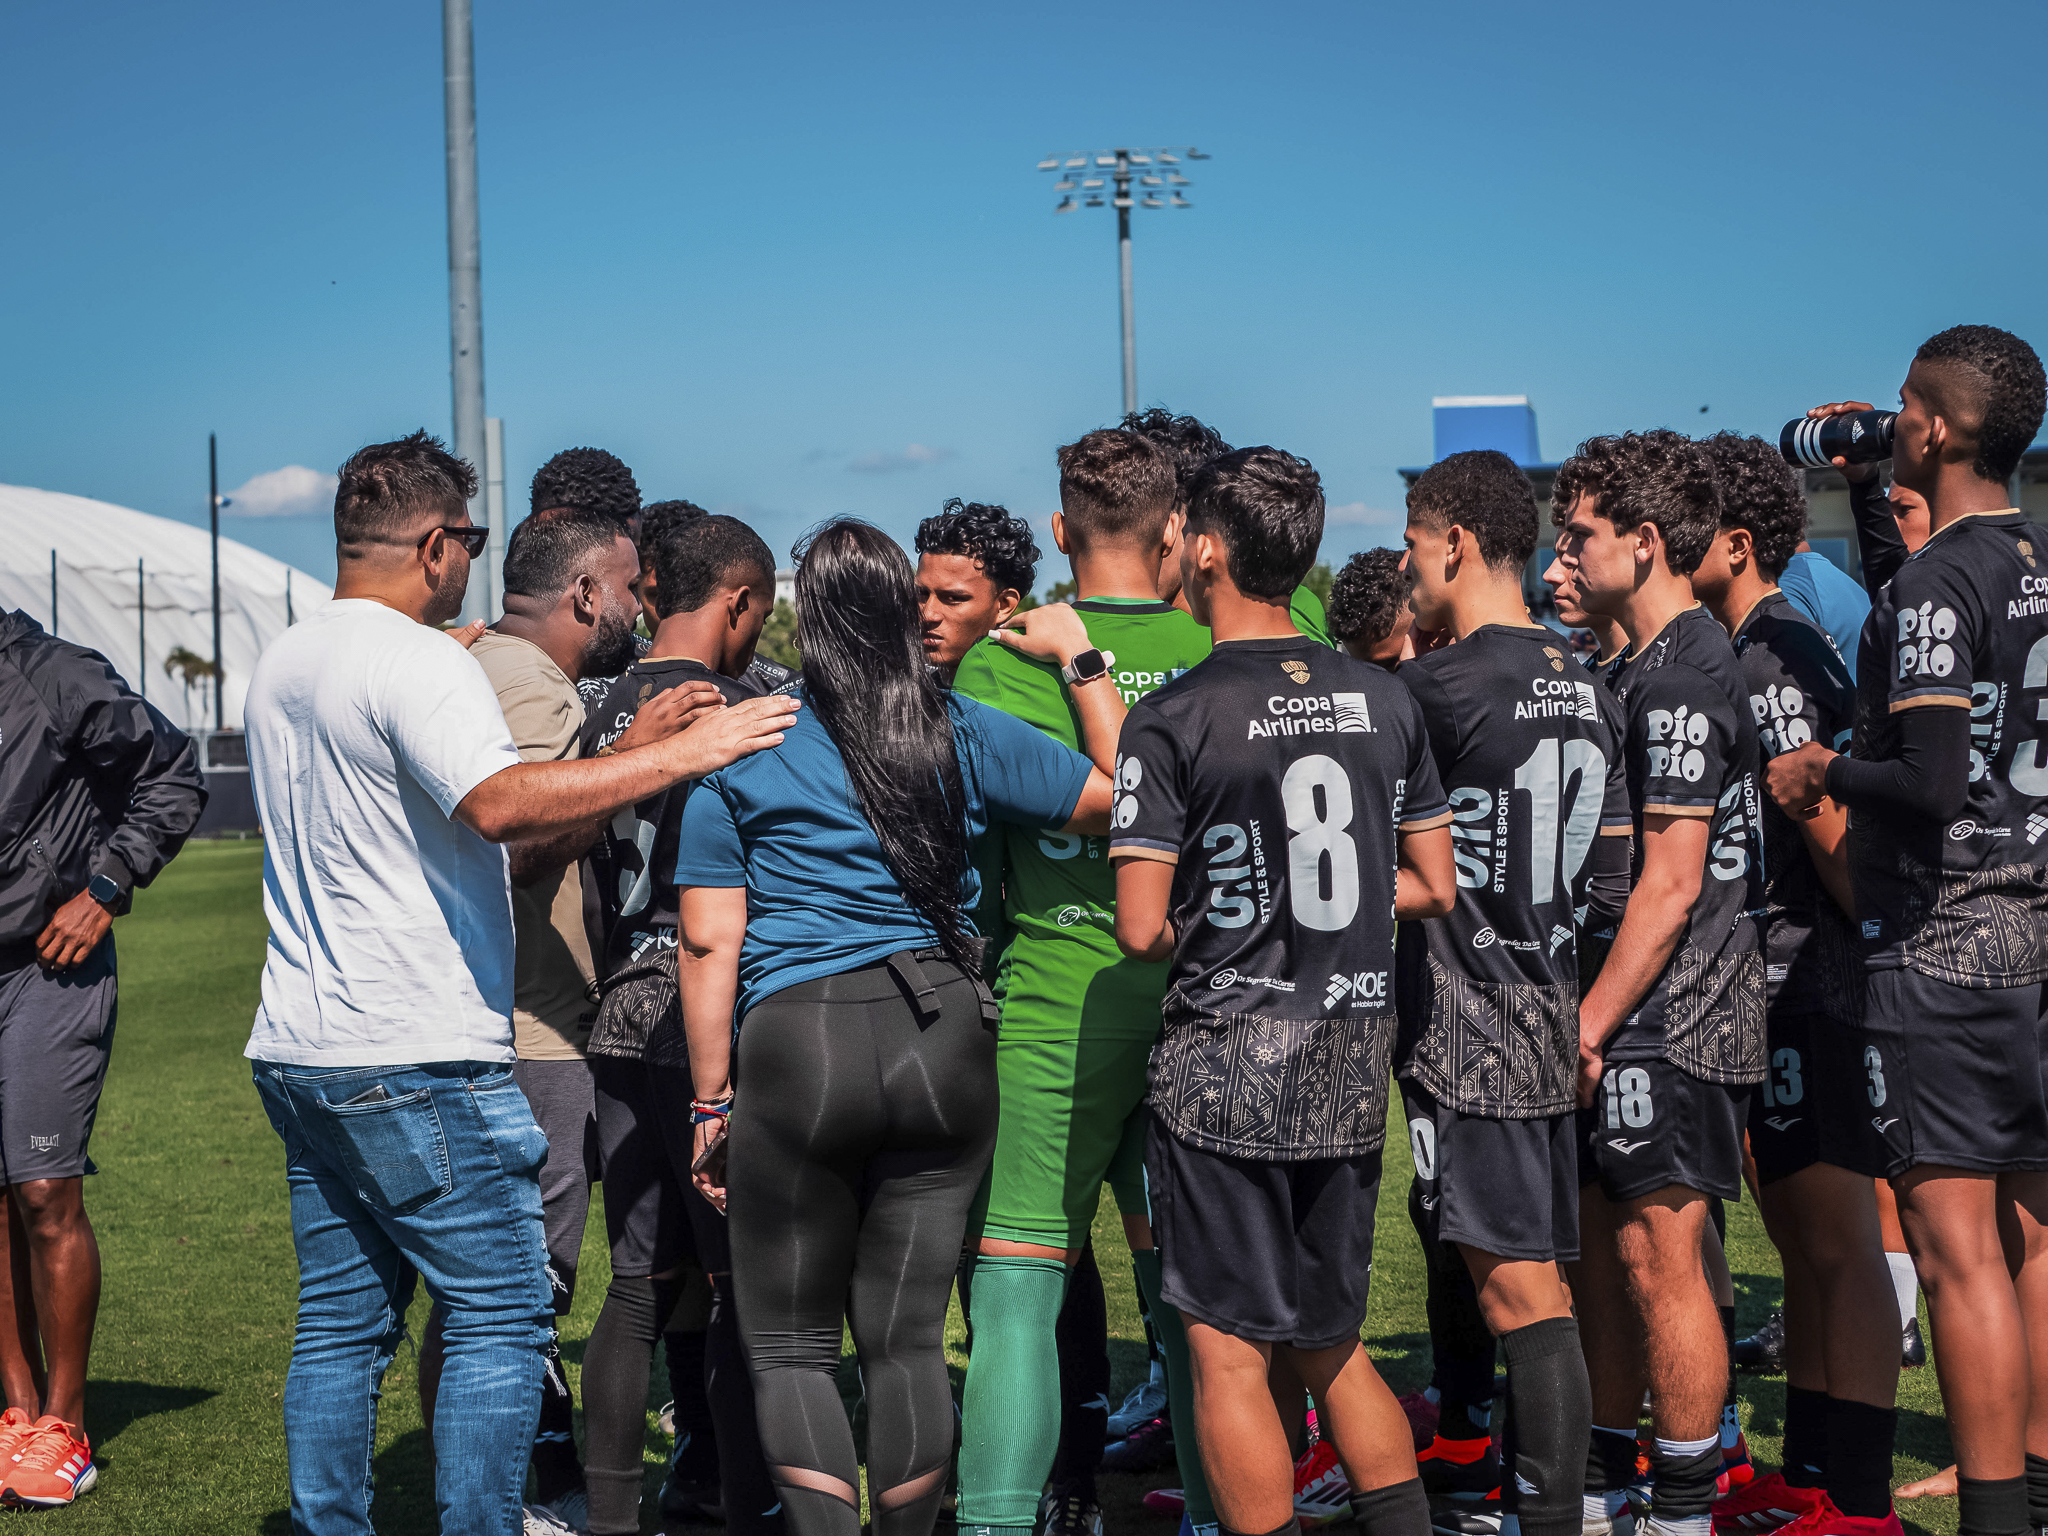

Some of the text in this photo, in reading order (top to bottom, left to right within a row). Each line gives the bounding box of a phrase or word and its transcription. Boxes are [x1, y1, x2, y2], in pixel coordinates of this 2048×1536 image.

[2007, 596, 2048, 620] Airlin
[1268, 695, 1331, 715] Copa
[1533, 678, 1576, 698] Cop
[1995, 681, 2009, 728] SPORT
[615, 712, 635, 729] Co
[1247, 716, 1336, 740] Airlines
[1281, 754, 1360, 932] 8
[1494, 788, 1509, 893] STYLE & SPORT
[1514, 738, 1606, 906] 10
[1249, 819, 1271, 924] STYLE & SPORT
[1352, 971, 1388, 999] KOE
[1602, 1067, 1654, 1129] 18
[1761, 1047, 1804, 1107] 13
[1864, 1045, 1887, 1108] 3
[30, 1133, 60, 1150] EVERLAST
